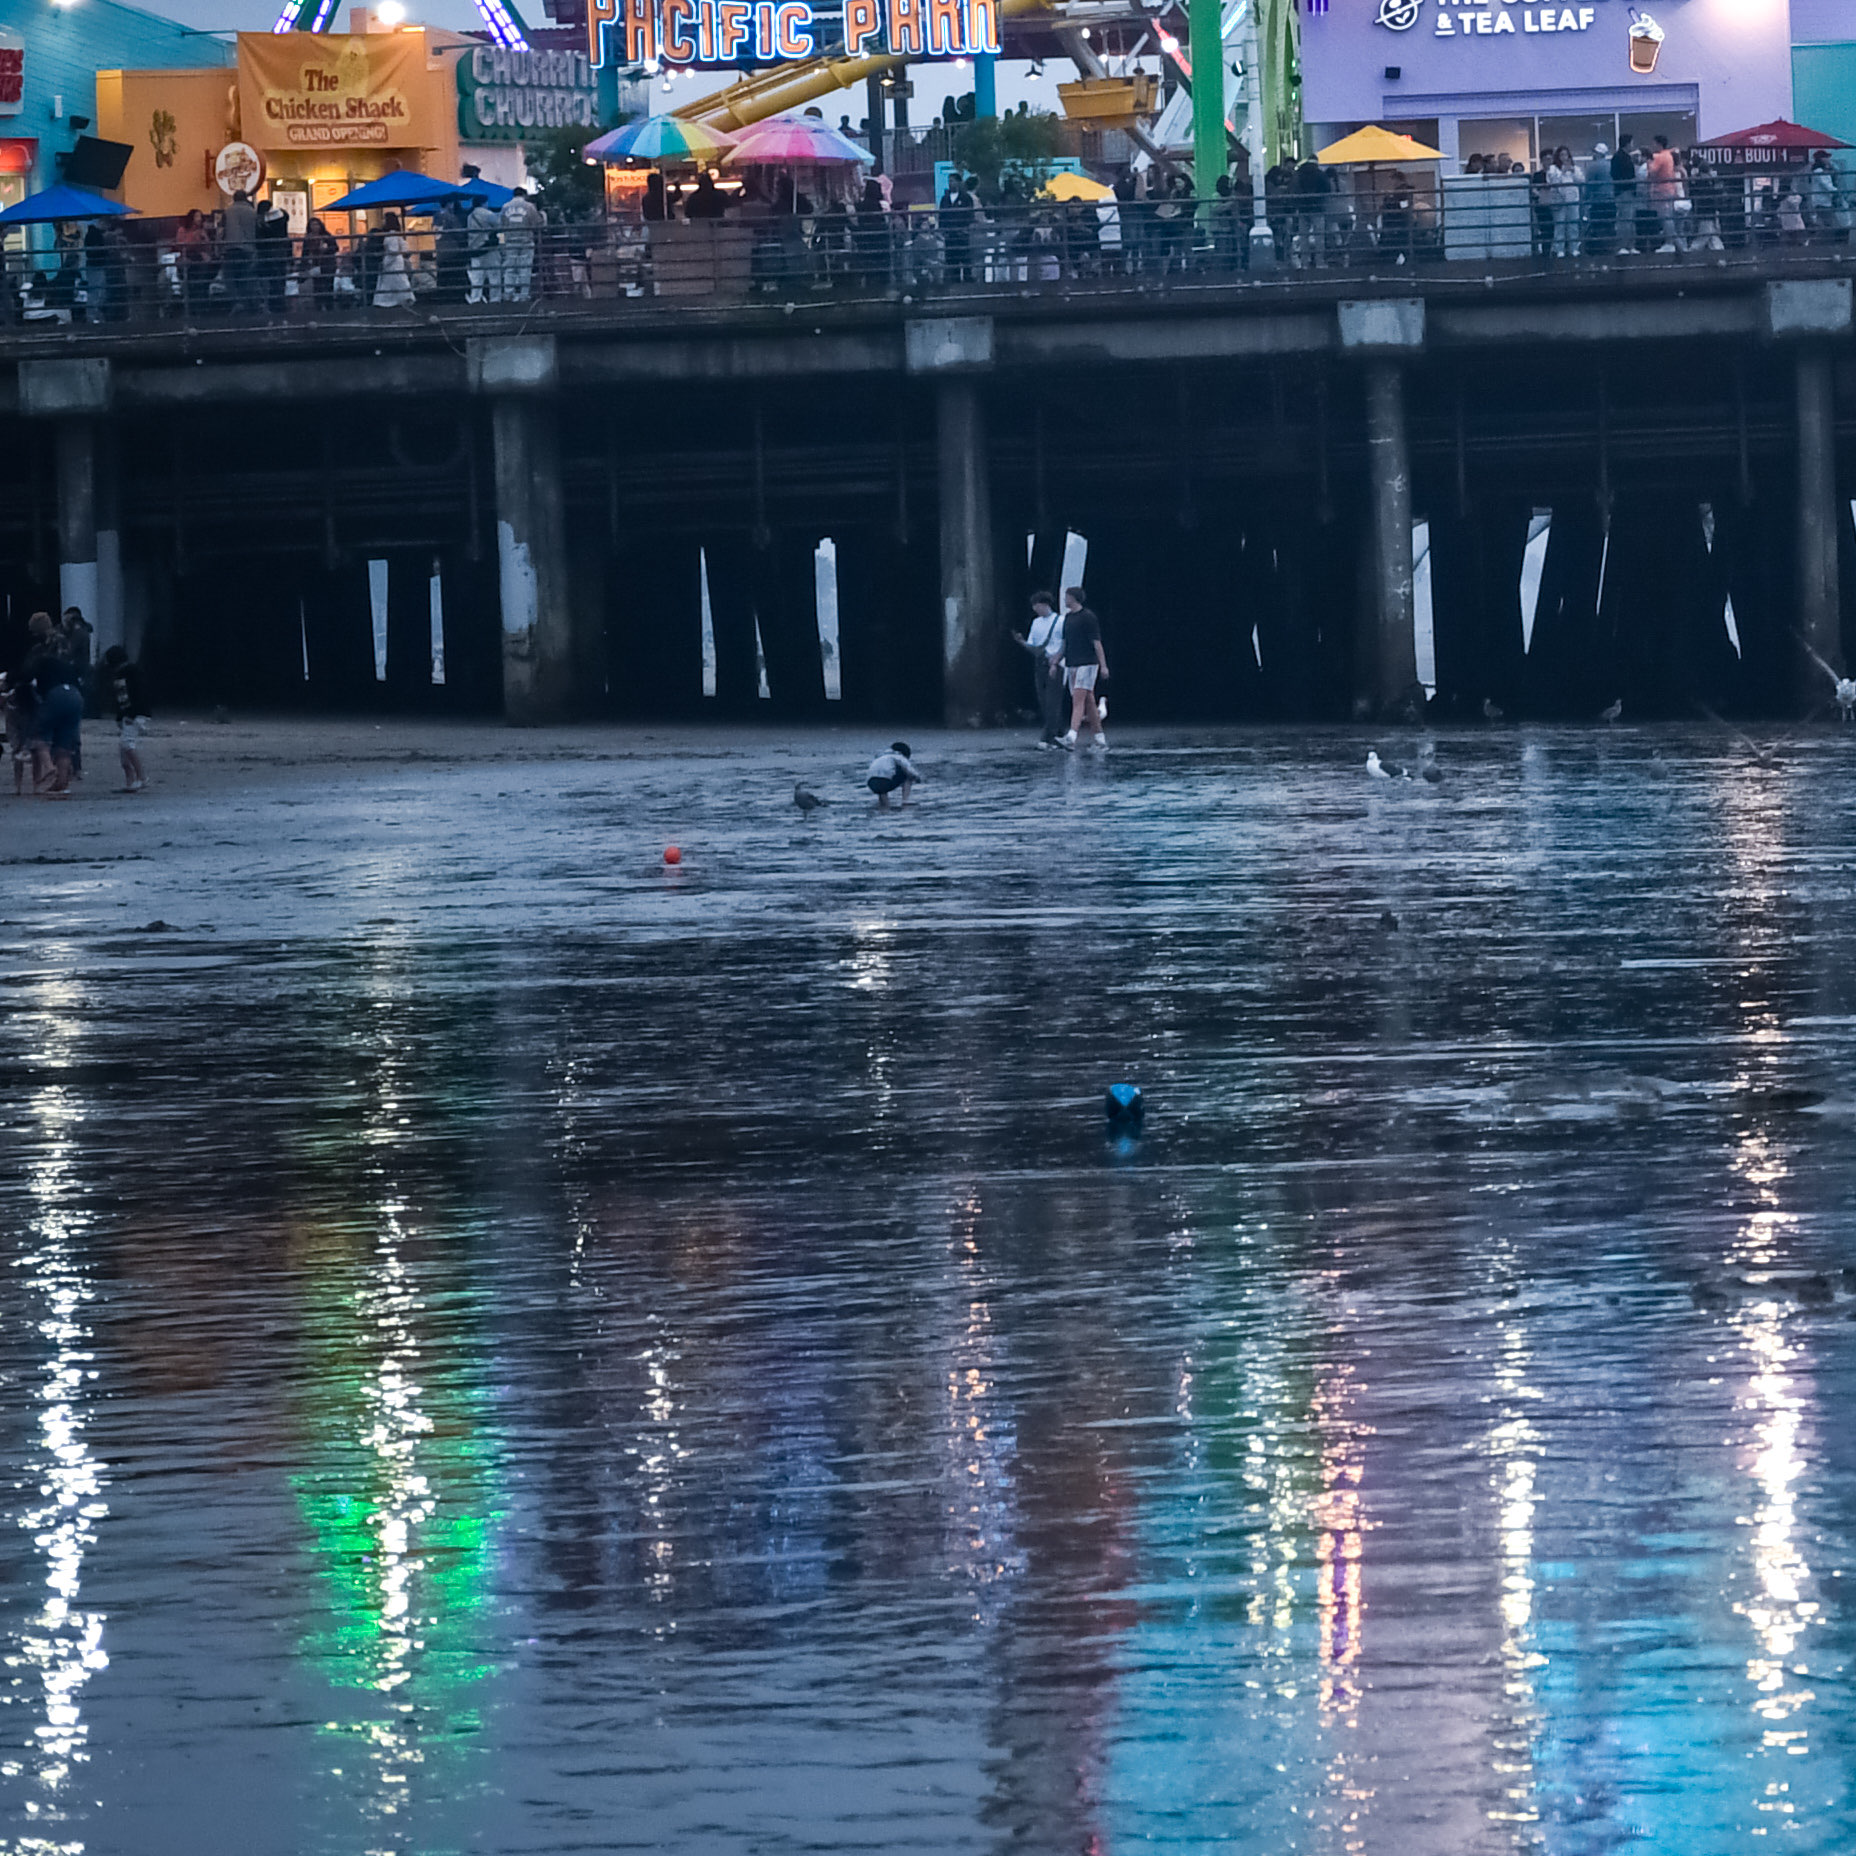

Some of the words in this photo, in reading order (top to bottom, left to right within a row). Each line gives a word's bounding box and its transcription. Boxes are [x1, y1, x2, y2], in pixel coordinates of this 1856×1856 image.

[1434, 13, 1456, 35] &
[1458, 11, 1515, 34] TEA
[1523, 8, 1595, 32] LEAF
[304, 69, 339, 92] The
[265, 96, 341, 120] Chicken
[345, 96, 404, 120] Shack
[289, 127, 331, 141] GRAND
[332, 126, 386, 140] OPENING!
